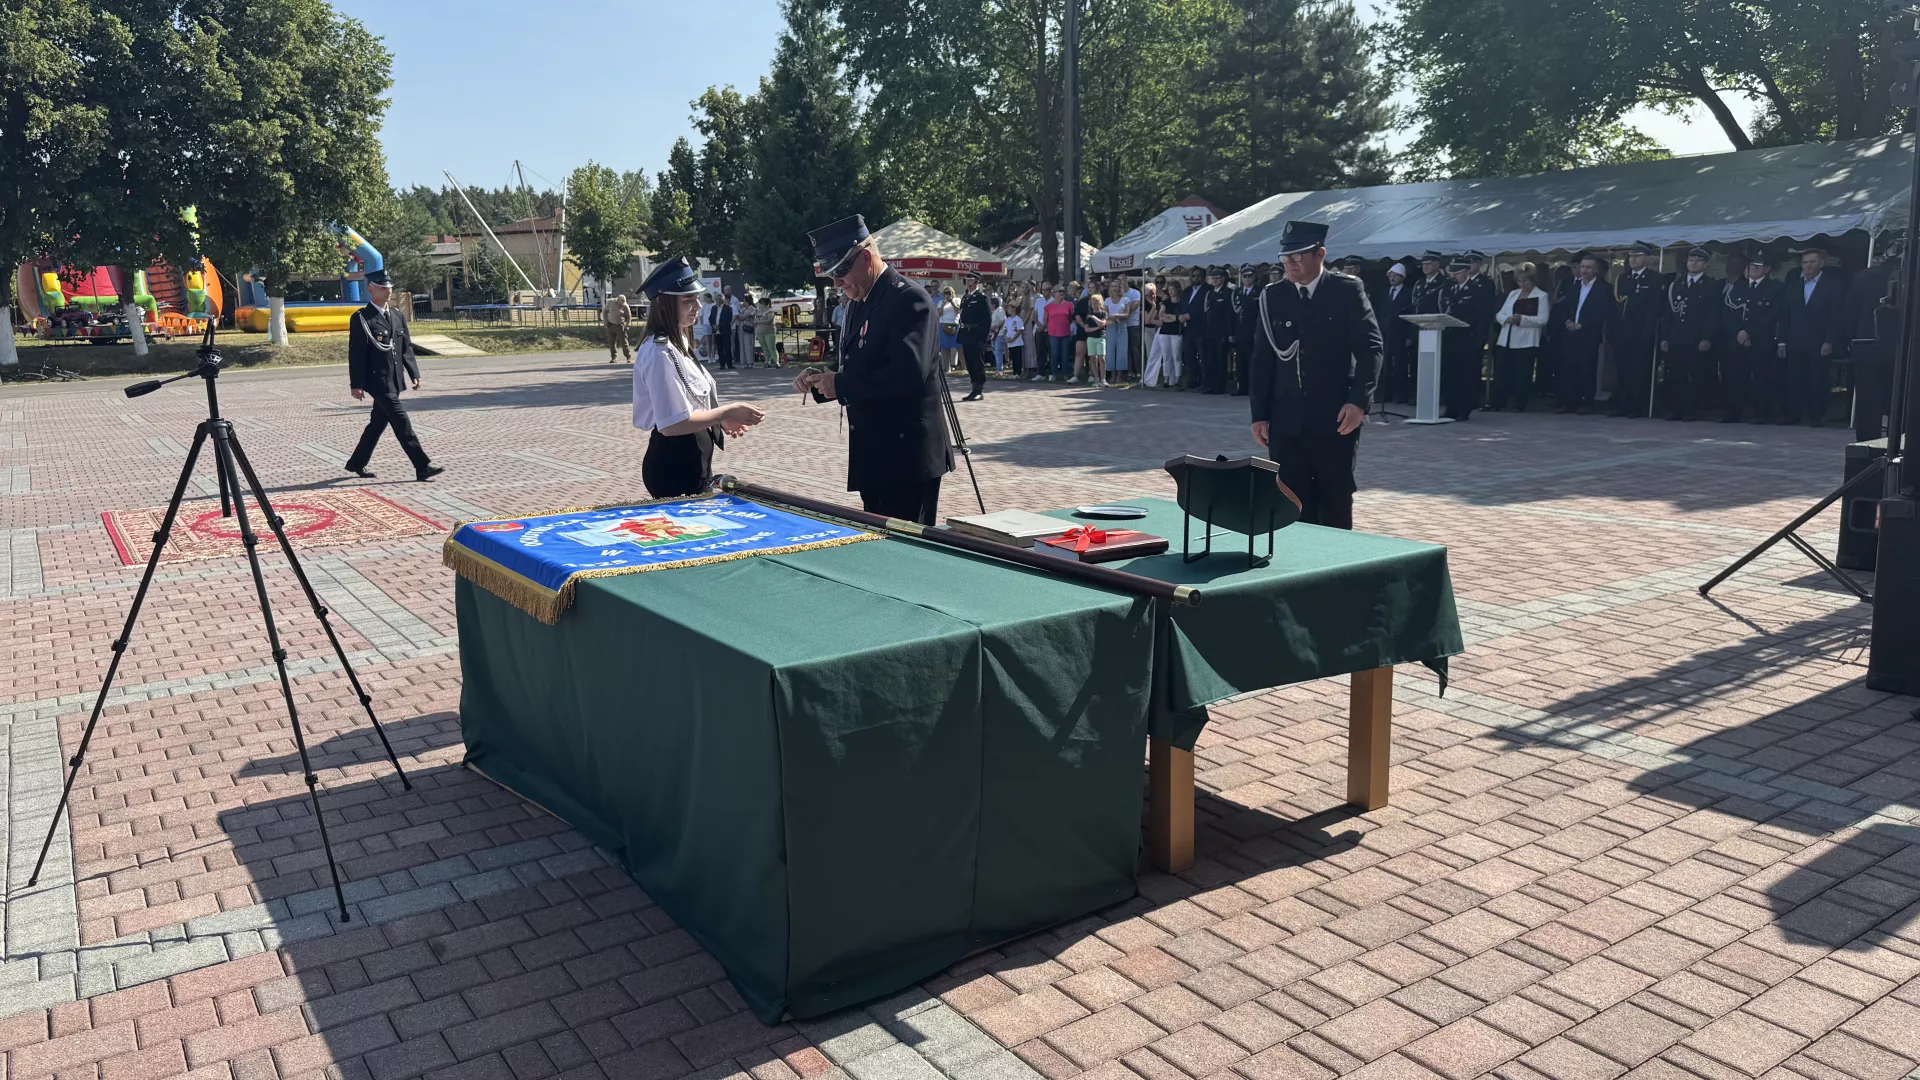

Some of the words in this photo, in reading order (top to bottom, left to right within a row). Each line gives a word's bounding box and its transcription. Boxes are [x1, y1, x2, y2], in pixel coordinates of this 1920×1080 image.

[1183, 215, 1202, 234] KIE
[956, 262, 980, 270] TYSKIE
[1111, 256, 1133, 268] TYSKIE
[601, 549, 625, 557] W
